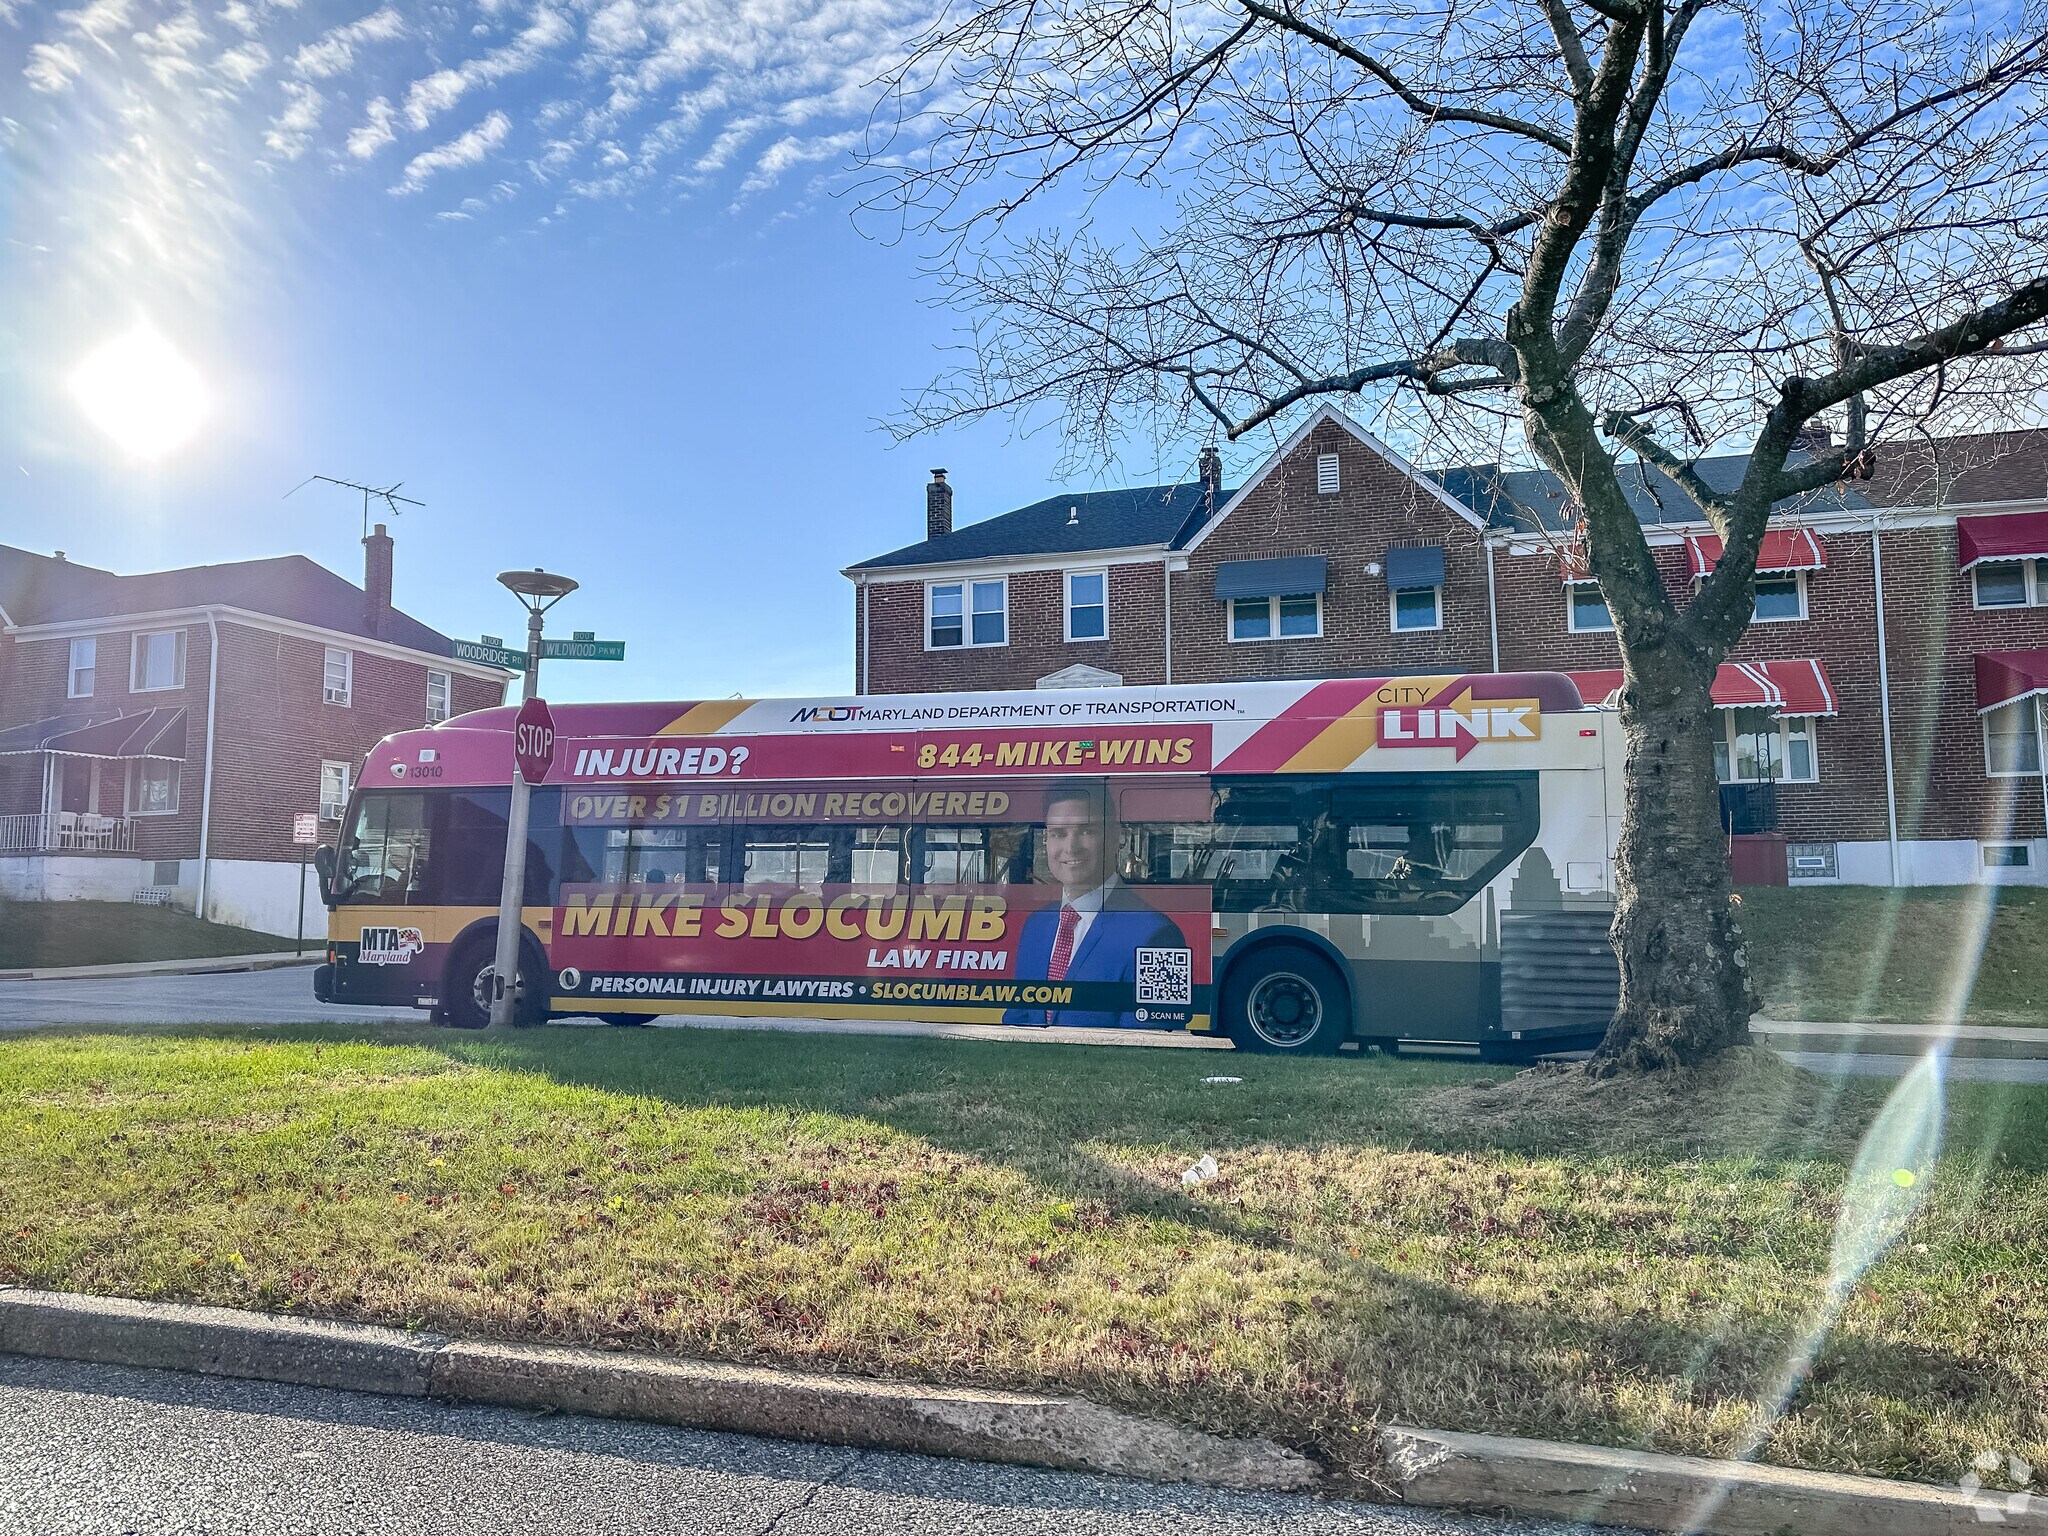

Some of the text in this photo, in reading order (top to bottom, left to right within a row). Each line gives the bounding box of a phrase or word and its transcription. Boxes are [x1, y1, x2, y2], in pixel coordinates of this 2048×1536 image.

[456, 643, 523, 665] WOODRIDGE RD
[546, 643, 622, 657] WILDWOOD PKWY
[1377, 687, 1431, 704] CITY
[859, 707, 944, 721] MARYLAND
[948, 703, 1056, 719] DEPARTMENT
[1059, 703, 1082, 716] OF
[1086, 699, 1236, 715] TRANSPORTATION
[1383, 706, 1537, 739] LINK
[517, 722, 553, 758] STOP
[573, 746, 750, 776] INJURED?
[916, 737, 1194, 769] 844-MIKE-WINS
[409, 766, 443, 778] 13010
[571, 791, 1010, 820] OVER $1 BILLION RECOVERED
[561, 893, 1008, 941] MIKE SLOCUMB
[362, 928, 399, 951] MTA
[360, 951, 409, 965] Maryland
[866, 948, 1008, 971] LAW FIRM
[590, 976, 1073, 1004] PERSONAL INJURY LAWYERS SLOCUMBLAW.COM
[1150, 1011, 1185, 1020] SCAN ME
